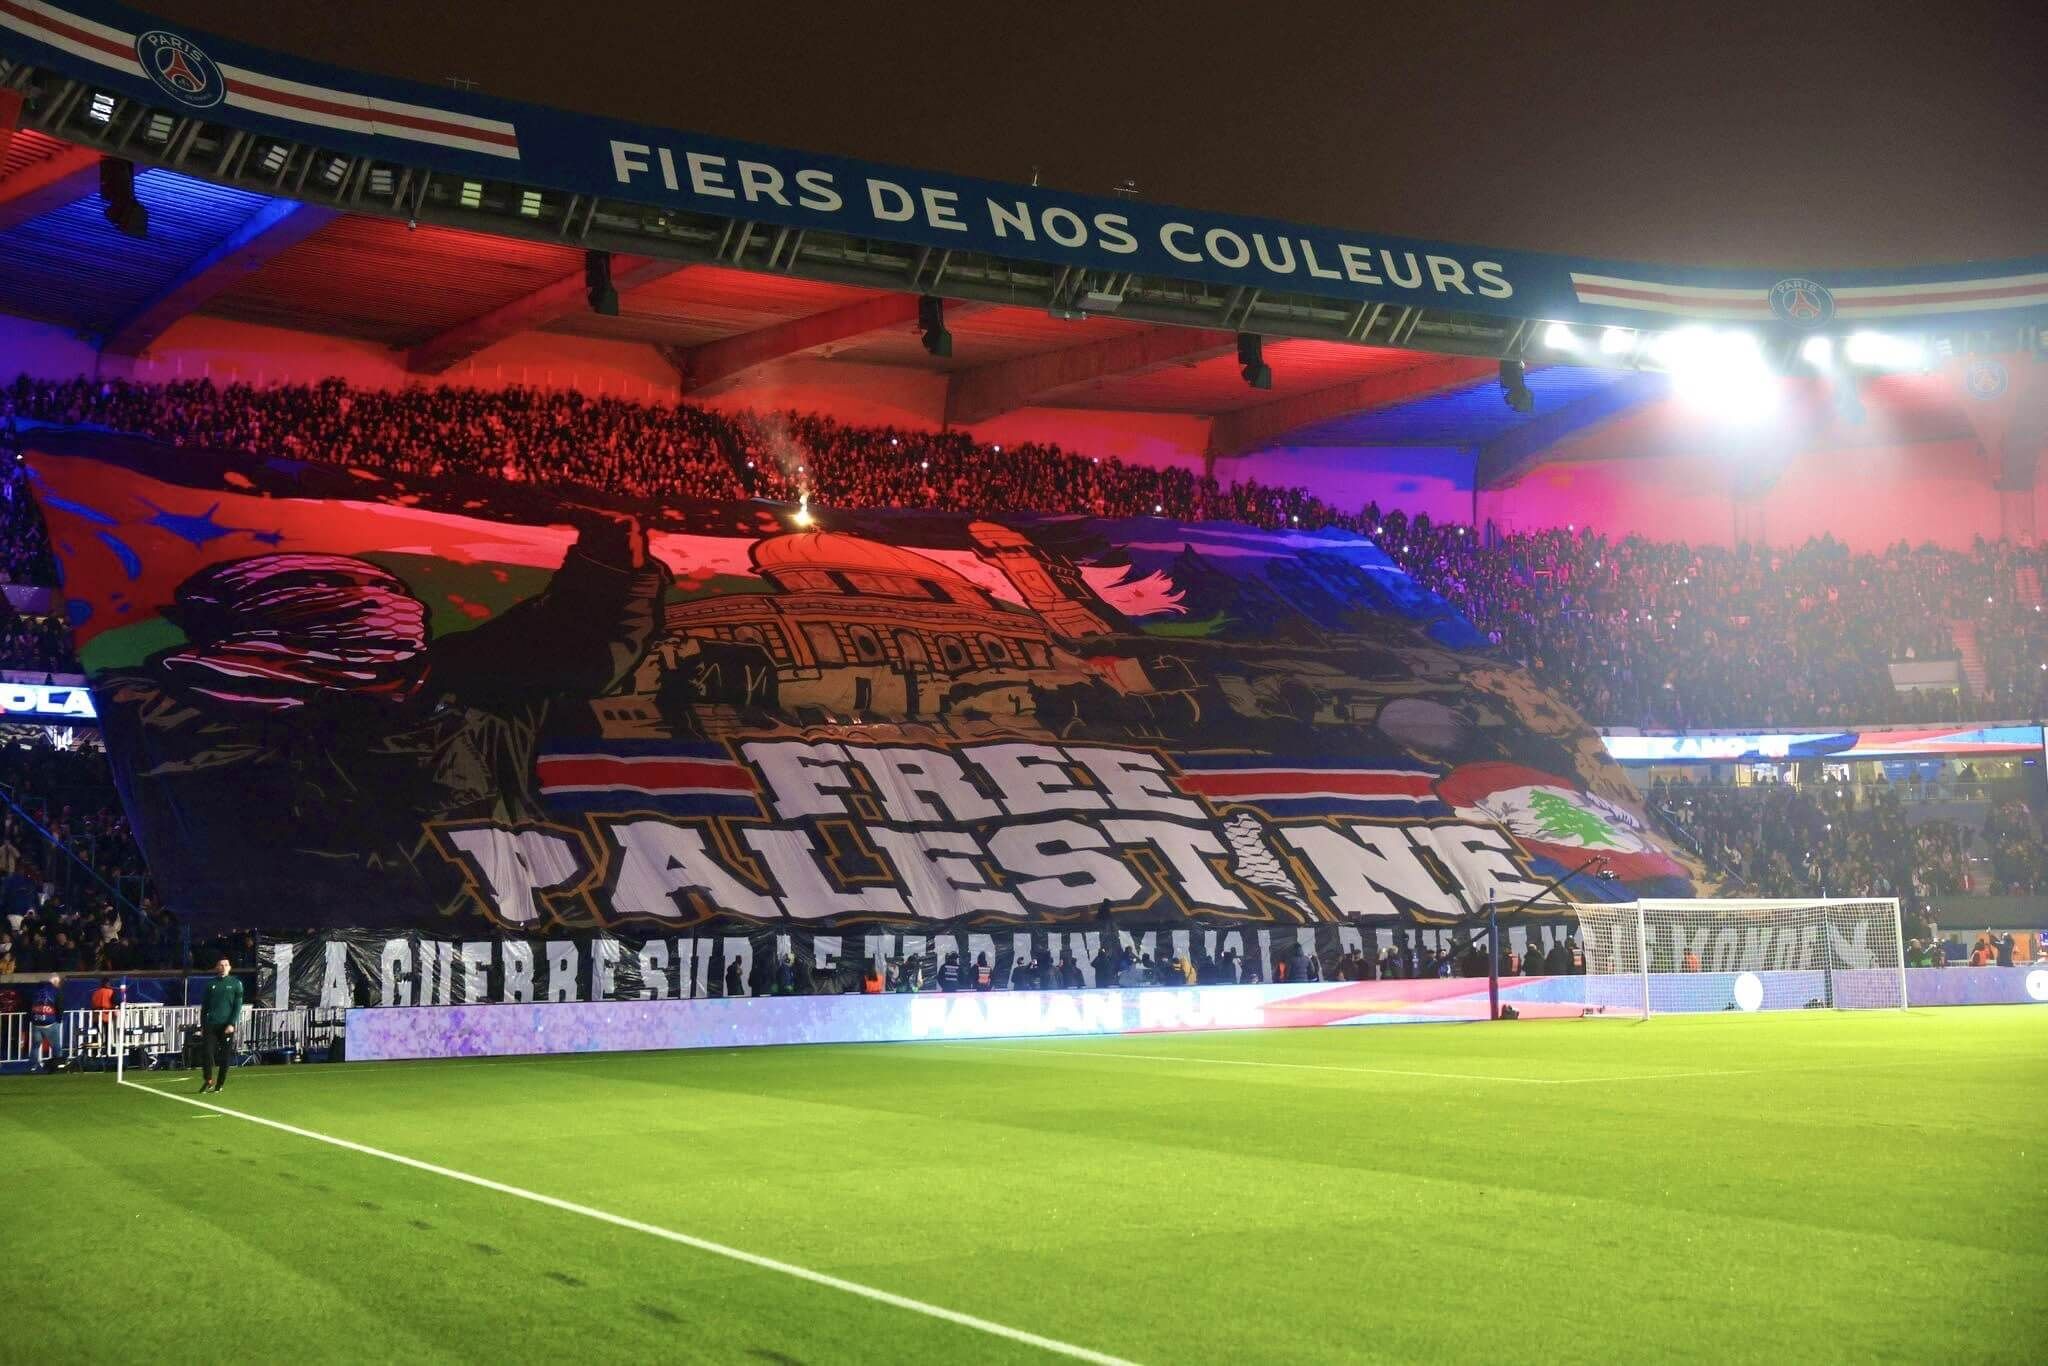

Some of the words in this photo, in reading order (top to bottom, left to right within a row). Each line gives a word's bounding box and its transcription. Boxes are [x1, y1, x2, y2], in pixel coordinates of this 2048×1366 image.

[148, 34, 204, 61] PARIS
[609, 139, 844, 212] FIERS
[866, 177, 969, 233] DE
[986, 196, 1139, 254] NOS
[1159, 222, 1514, 300] COULEURS
[740, 741, 1207, 823] FREE
[448, 812, 1568, 924] PALESTINE
[381, 938, 620, 1006] GUERRE
[638, 935, 753, 1000] SUR
